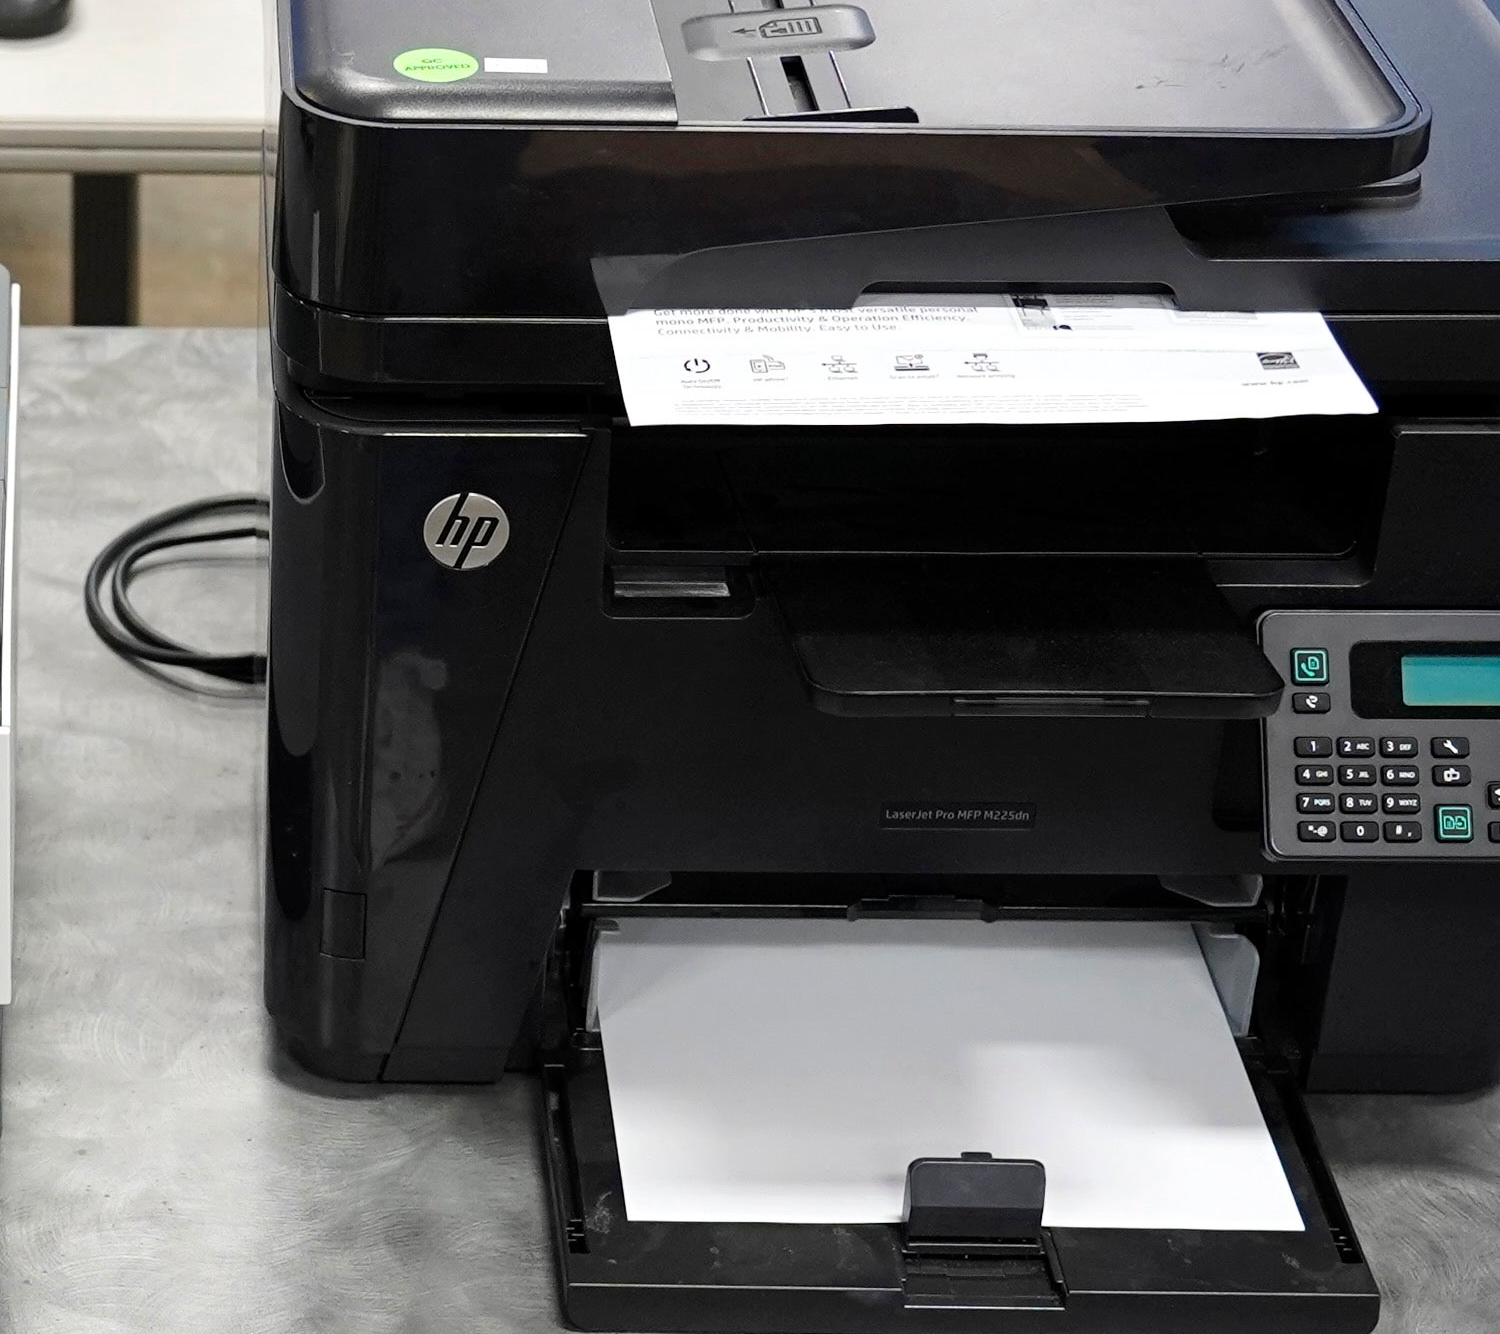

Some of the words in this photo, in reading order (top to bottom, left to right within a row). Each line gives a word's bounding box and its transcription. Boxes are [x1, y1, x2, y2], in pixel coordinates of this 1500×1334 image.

[733, 316, 814, 324] Productivity
[831, 315, 899, 323] Operation
[658, 328, 740, 336] Connectivity
[430, 493, 503, 569] hp
[885, 809, 932, 820] LaserJet
[935, 810, 955, 820] Pro
[957, 810, 981, 820] MFP
[983, 810, 1030, 821] M225dn
